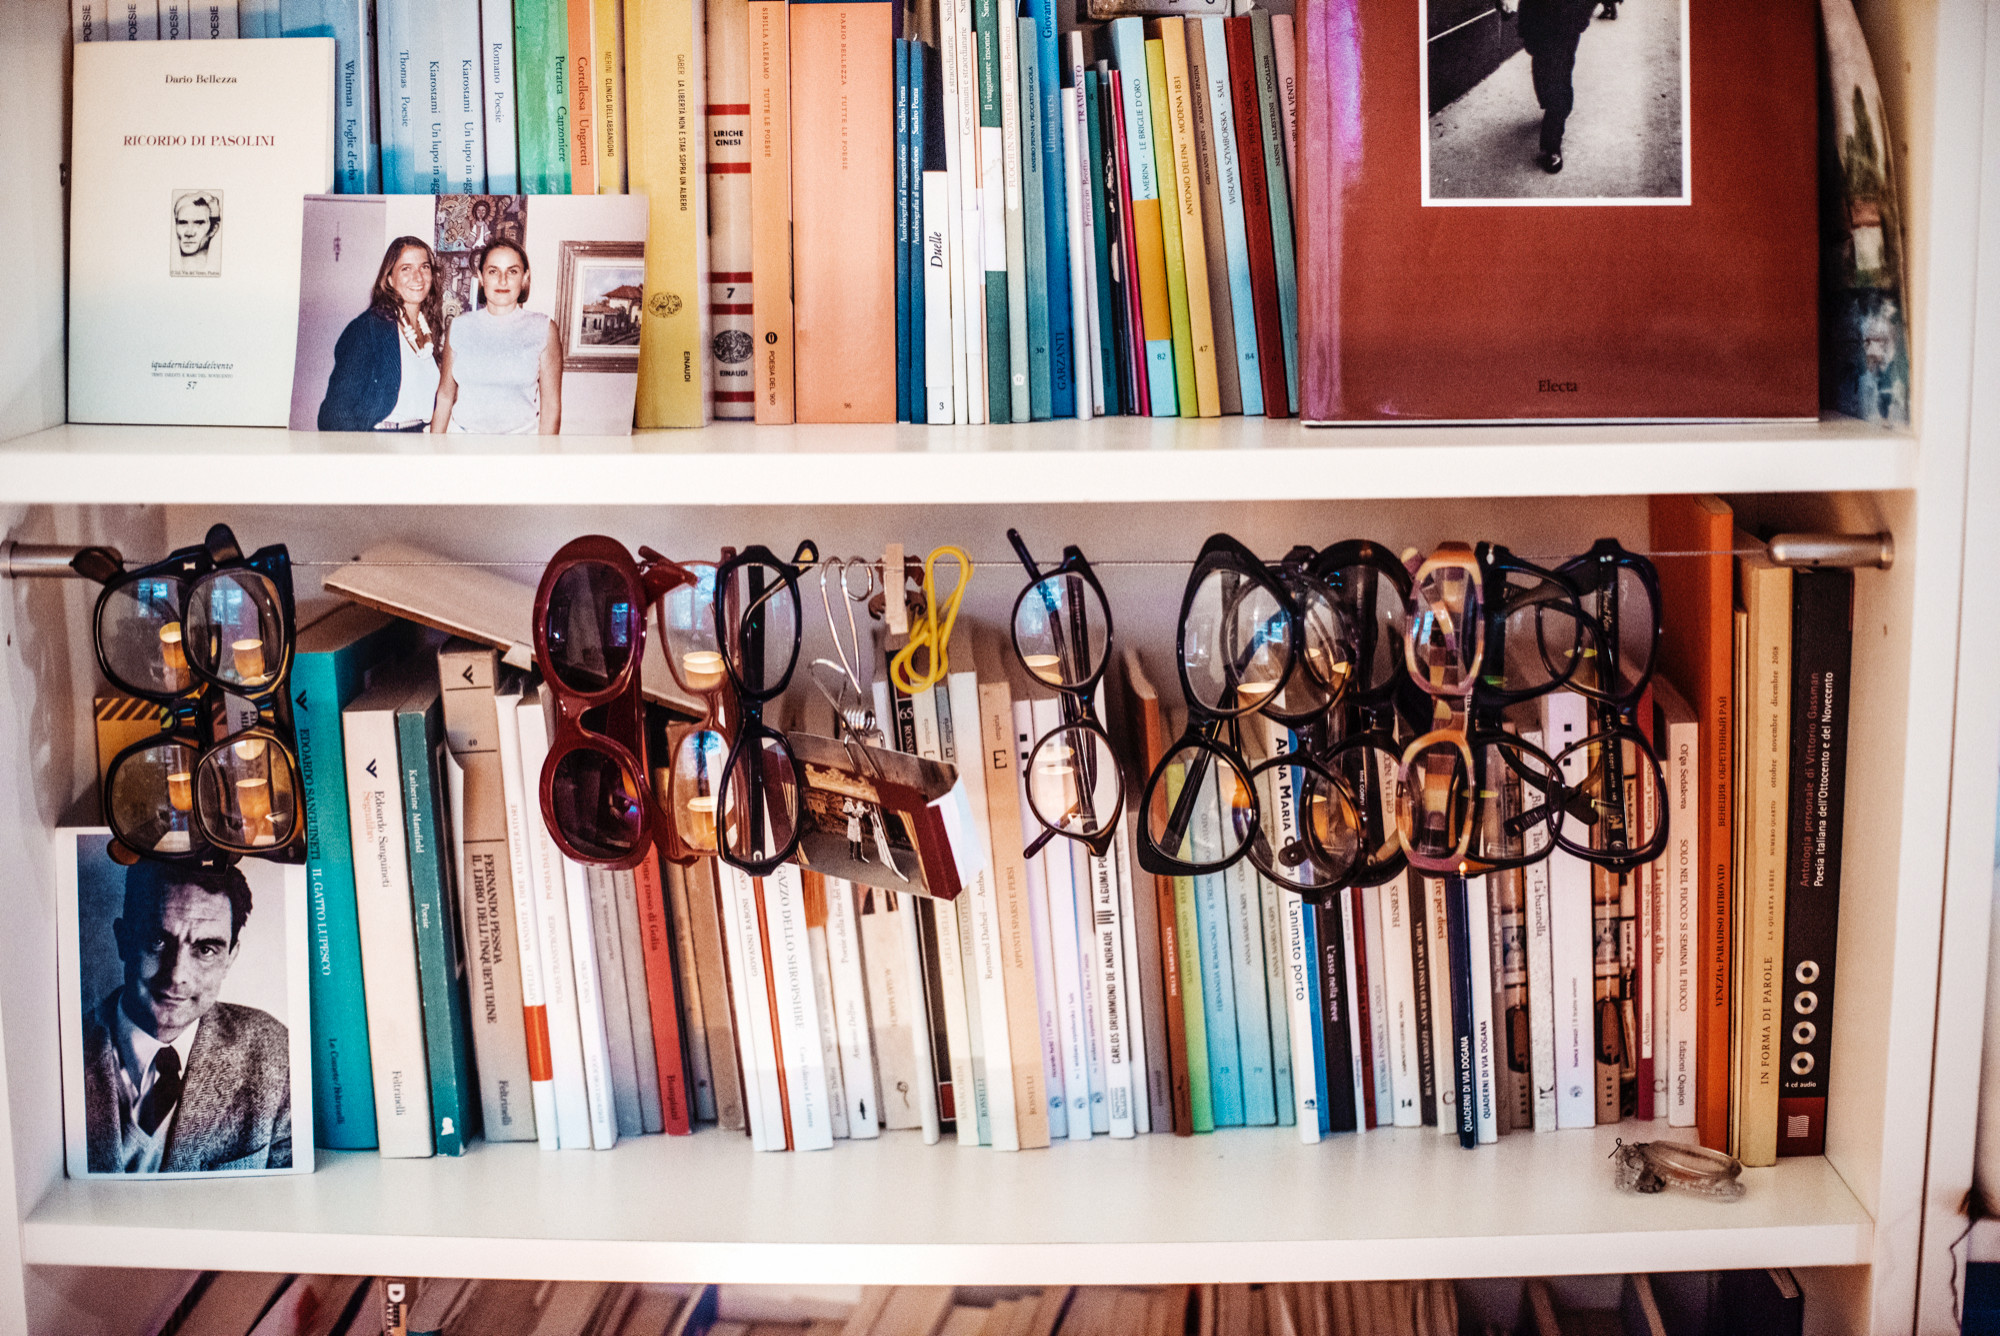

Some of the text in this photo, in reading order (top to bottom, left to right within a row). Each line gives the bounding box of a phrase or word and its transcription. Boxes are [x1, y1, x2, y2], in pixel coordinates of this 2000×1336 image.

[83, 5, 91, 42] POESIE
[983, 31, 991, 60] insonne
[165, 74, 237, 83] Dario Bellezza
[400, 50, 410, 127] Thomas Poesie
[493, 43, 504, 123] Romano Poesie
[678, 80, 684, 88] LA
[983, 62, 993, 102] viaggiatore
[1075, 65, 1086, 124] TRAMONTO
[1216, 79, 1224, 97] SALE
[344, 60, 357, 181] Whitman Foglie d'erba
[429, 61, 442, 174] Kiarostami Un lupo in
[555, 56, 567, 162] Petrarca Canzoniere
[577, 57, 590, 166] Cortellessa Ungaretti
[606, 105, 614, 157] DELL'ABBANDONO
[764, 117, 770, 127] LE
[123, 135, 275, 146] RICORDO DI PASOLINI
[1133, 79, 1150, 191] MERINI LE BRIGLIE D'ORO
[1174, 76, 1194, 216] ANTONIO DELFINI MODENA 1831
[1220, 111, 1232, 165] SZYMBORSKA
[680, 177, 686, 185] UN
[929, 232, 943, 268] Duelle
[727, 288, 735, 298] 7
[1056, 333, 1066, 390] GARZANTI
[186, 381, 197, 390] 57
[1538, 380, 1577, 392] Electa
[1718, 696, 1727, 715] РАЙ
[1771, 670, 1779, 707] dicembre
[1822, 672, 1833, 722] Novecento
[1820, 726, 1831, 740] del
[1680, 769, 1689, 809] Sedakova
[1770, 759, 1778, 788] ottobre
[1800, 673, 1819, 887] Antologia personale di Vittorio Gassman
[1817, 751, 1830, 817] dell'Ottocento
[362, 791, 374, 842] Segnalibro
[374, 791, 392, 887] Edoardo Sanguineti
[1815, 821, 1827, 854] italiana
[300, 729, 331, 975] EDOARDO SANGUINETI IL GATTO LUPESCO
[408, 769, 431, 928] Katherine Mansfield Poesie
[1680, 839, 1689, 865] SOLO
[1006, 866, 1016, 890] PERSI
[1680, 868, 1688, 885] NEL
[1814, 858, 1825, 886] Poesia
[484, 854, 502, 964] FERNANDO PESSOA
[1009, 900, 1019, 929] SPARSI
[1434, 880, 1446, 939] Tre per dieci
[1655, 868, 1664, 964] La televisione di Dio
[1680, 887, 1688, 920] FUOCO
[472, 854, 497, 1024] IL LIBRO DELL'INQUIETUDINE
[1680, 923, 1688, 931] SI
[1715, 864, 1725, 1006] VENEZIA: PARADISO RITROVATO
[782, 910, 804, 1029] DELLO SHROPSHIRE
[1009, 931, 1023, 969] APPUNTI
[1099, 871, 1121, 1063] CARLOS DRUMMOND DE ANDRADE ALGUMA
[1288, 900, 1305, 1001] L'animato porto
[1680, 934, 1688, 966] SEMINA
[1326, 945, 1338, 1022] L'asso nella neve
[1679, 979, 1688, 1012] FUOCO
[1680, 969, 1688, 977] IL
[1761, 957, 1773, 1084] IN FORMA DI PAROLE
[1678, 1041, 1687, 1072] Edizioni
[392, 1071, 406, 1116] Feltrinelli
[499, 1080, 512, 1126] Feltrinelli
[667, 1075, 680, 1121] Bompiani
[1460, 1036, 1473, 1132] QUADERNI DI VIA DOGANA
